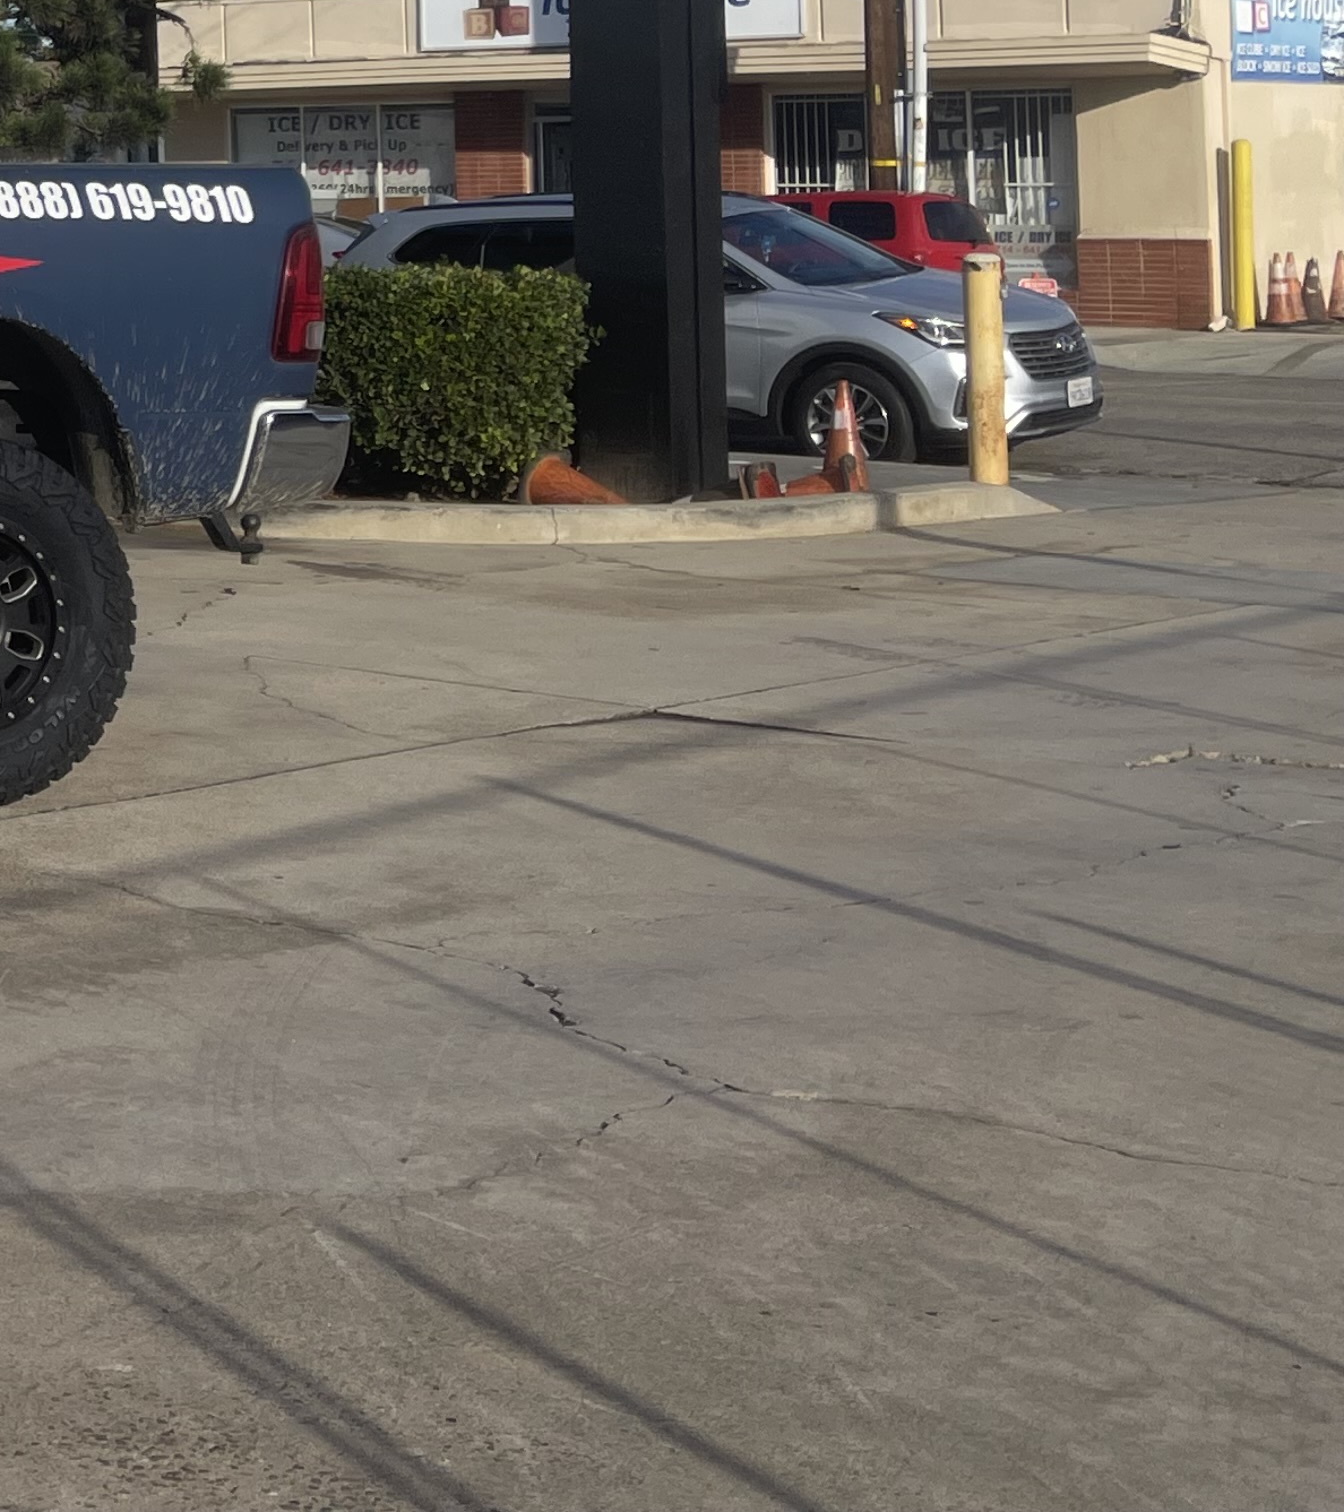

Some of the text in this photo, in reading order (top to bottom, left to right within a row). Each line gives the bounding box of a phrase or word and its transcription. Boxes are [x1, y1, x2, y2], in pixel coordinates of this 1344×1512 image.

[470, 14, 488, 35] B
[268, 116, 300, 132] ICE
[329, 115, 370, 130] DRY
[385, 114, 421, 130] ICE
[277, 139, 407, 154] Delvery & Pic Up
[383, 182, 454, 197] mergency)
[85, 182, 254, 223] 619-9810
[995, 231, 1013, 243] ICE
